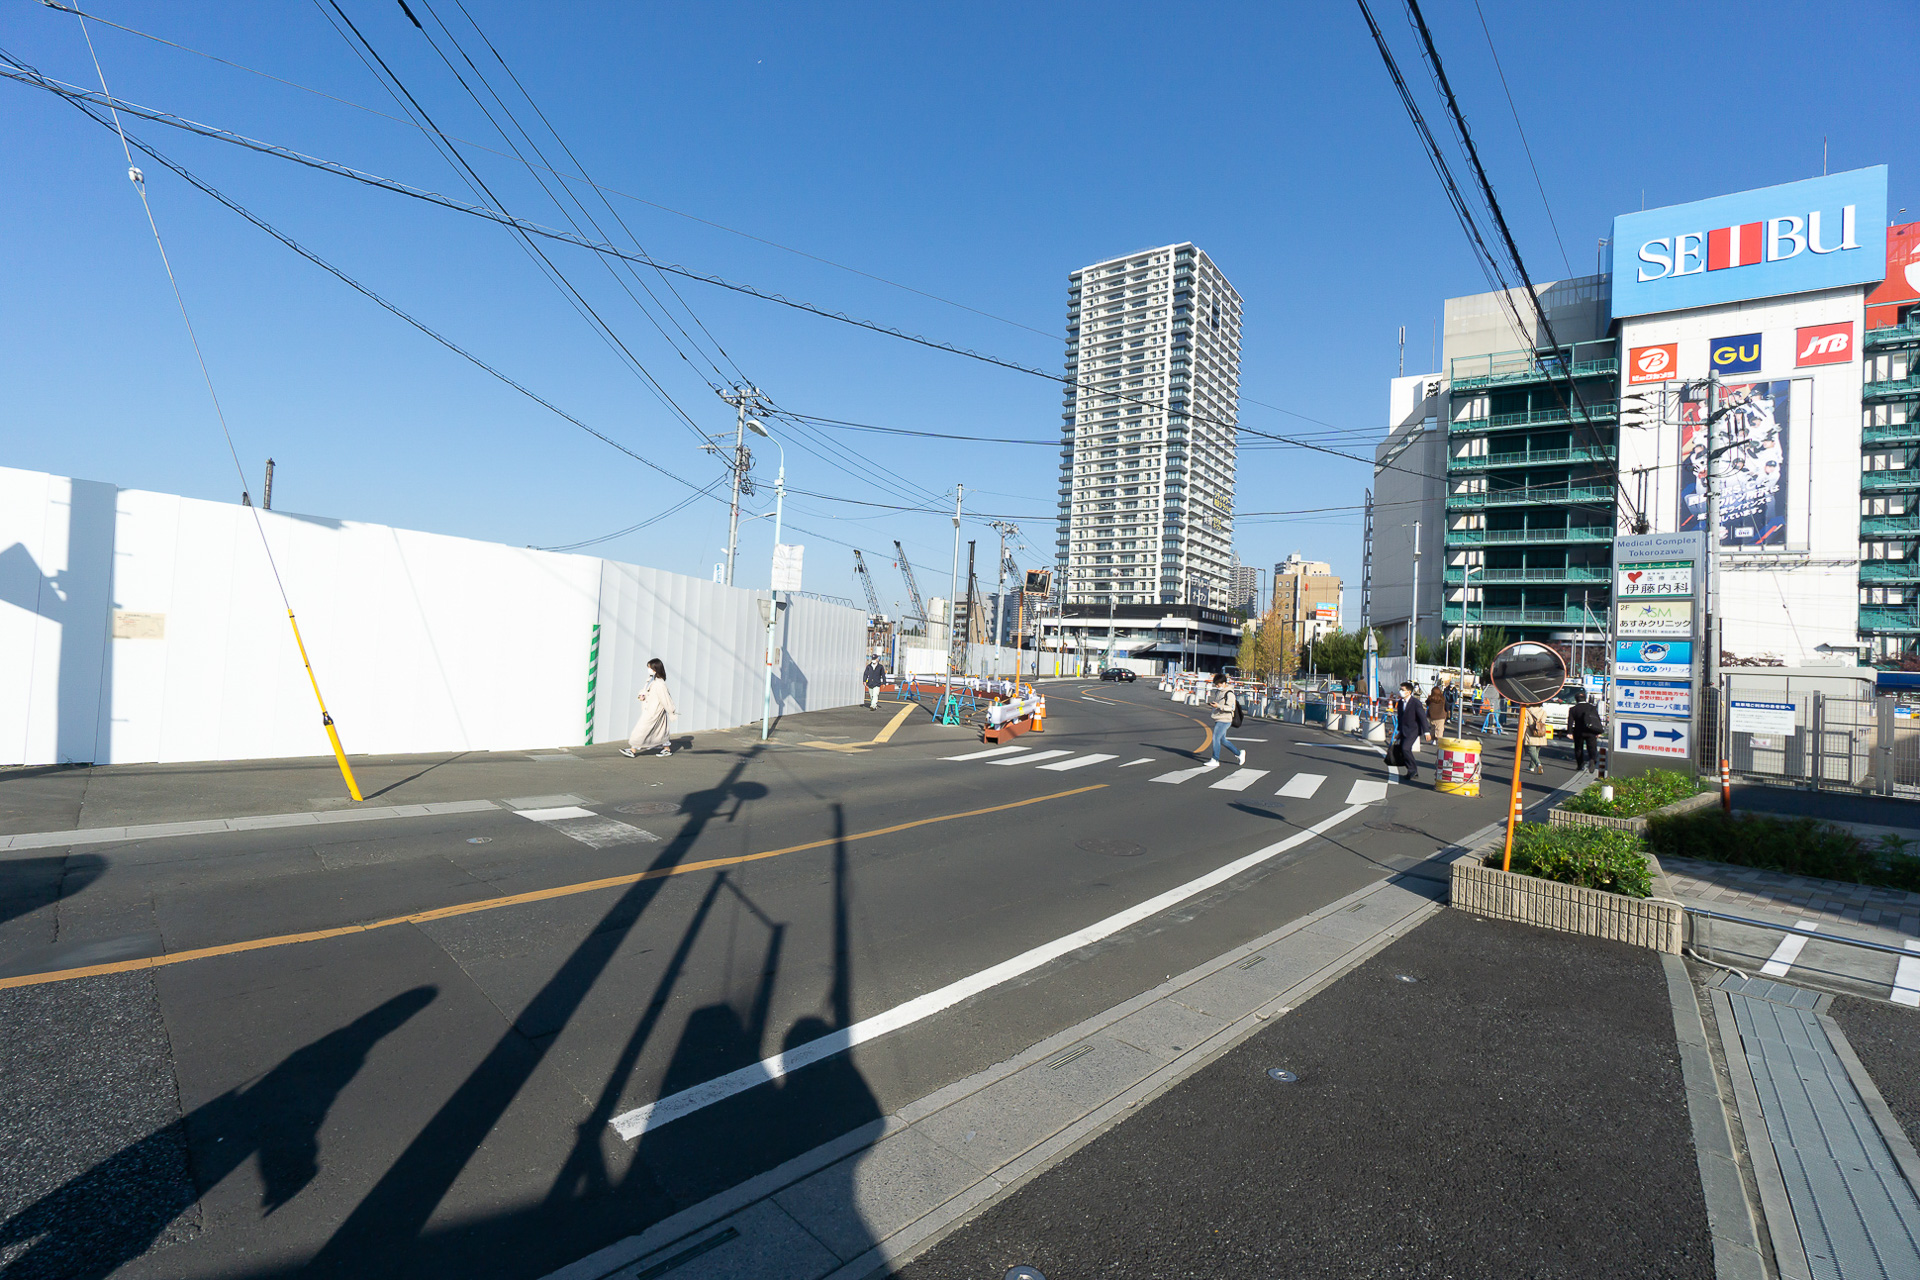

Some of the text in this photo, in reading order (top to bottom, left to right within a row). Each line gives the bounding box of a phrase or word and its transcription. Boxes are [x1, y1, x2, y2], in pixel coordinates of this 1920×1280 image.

[1637, 204, 1862, 283] SEIBU
[1800, 333, 1849, 359] JTB
[1713, 344, 1759, 365] GU
[1618, 537, 1697, 548] Medical Complex
[1629, 548, 1684, 557] Tokorozawa
[1625, 582, 1689, 594] 伊藤内科
[1638, 607, 1672, 618] ASM
[1620, 620, 1691, 628] あすみクリニック
[1620, 722, 1648, 749] P
